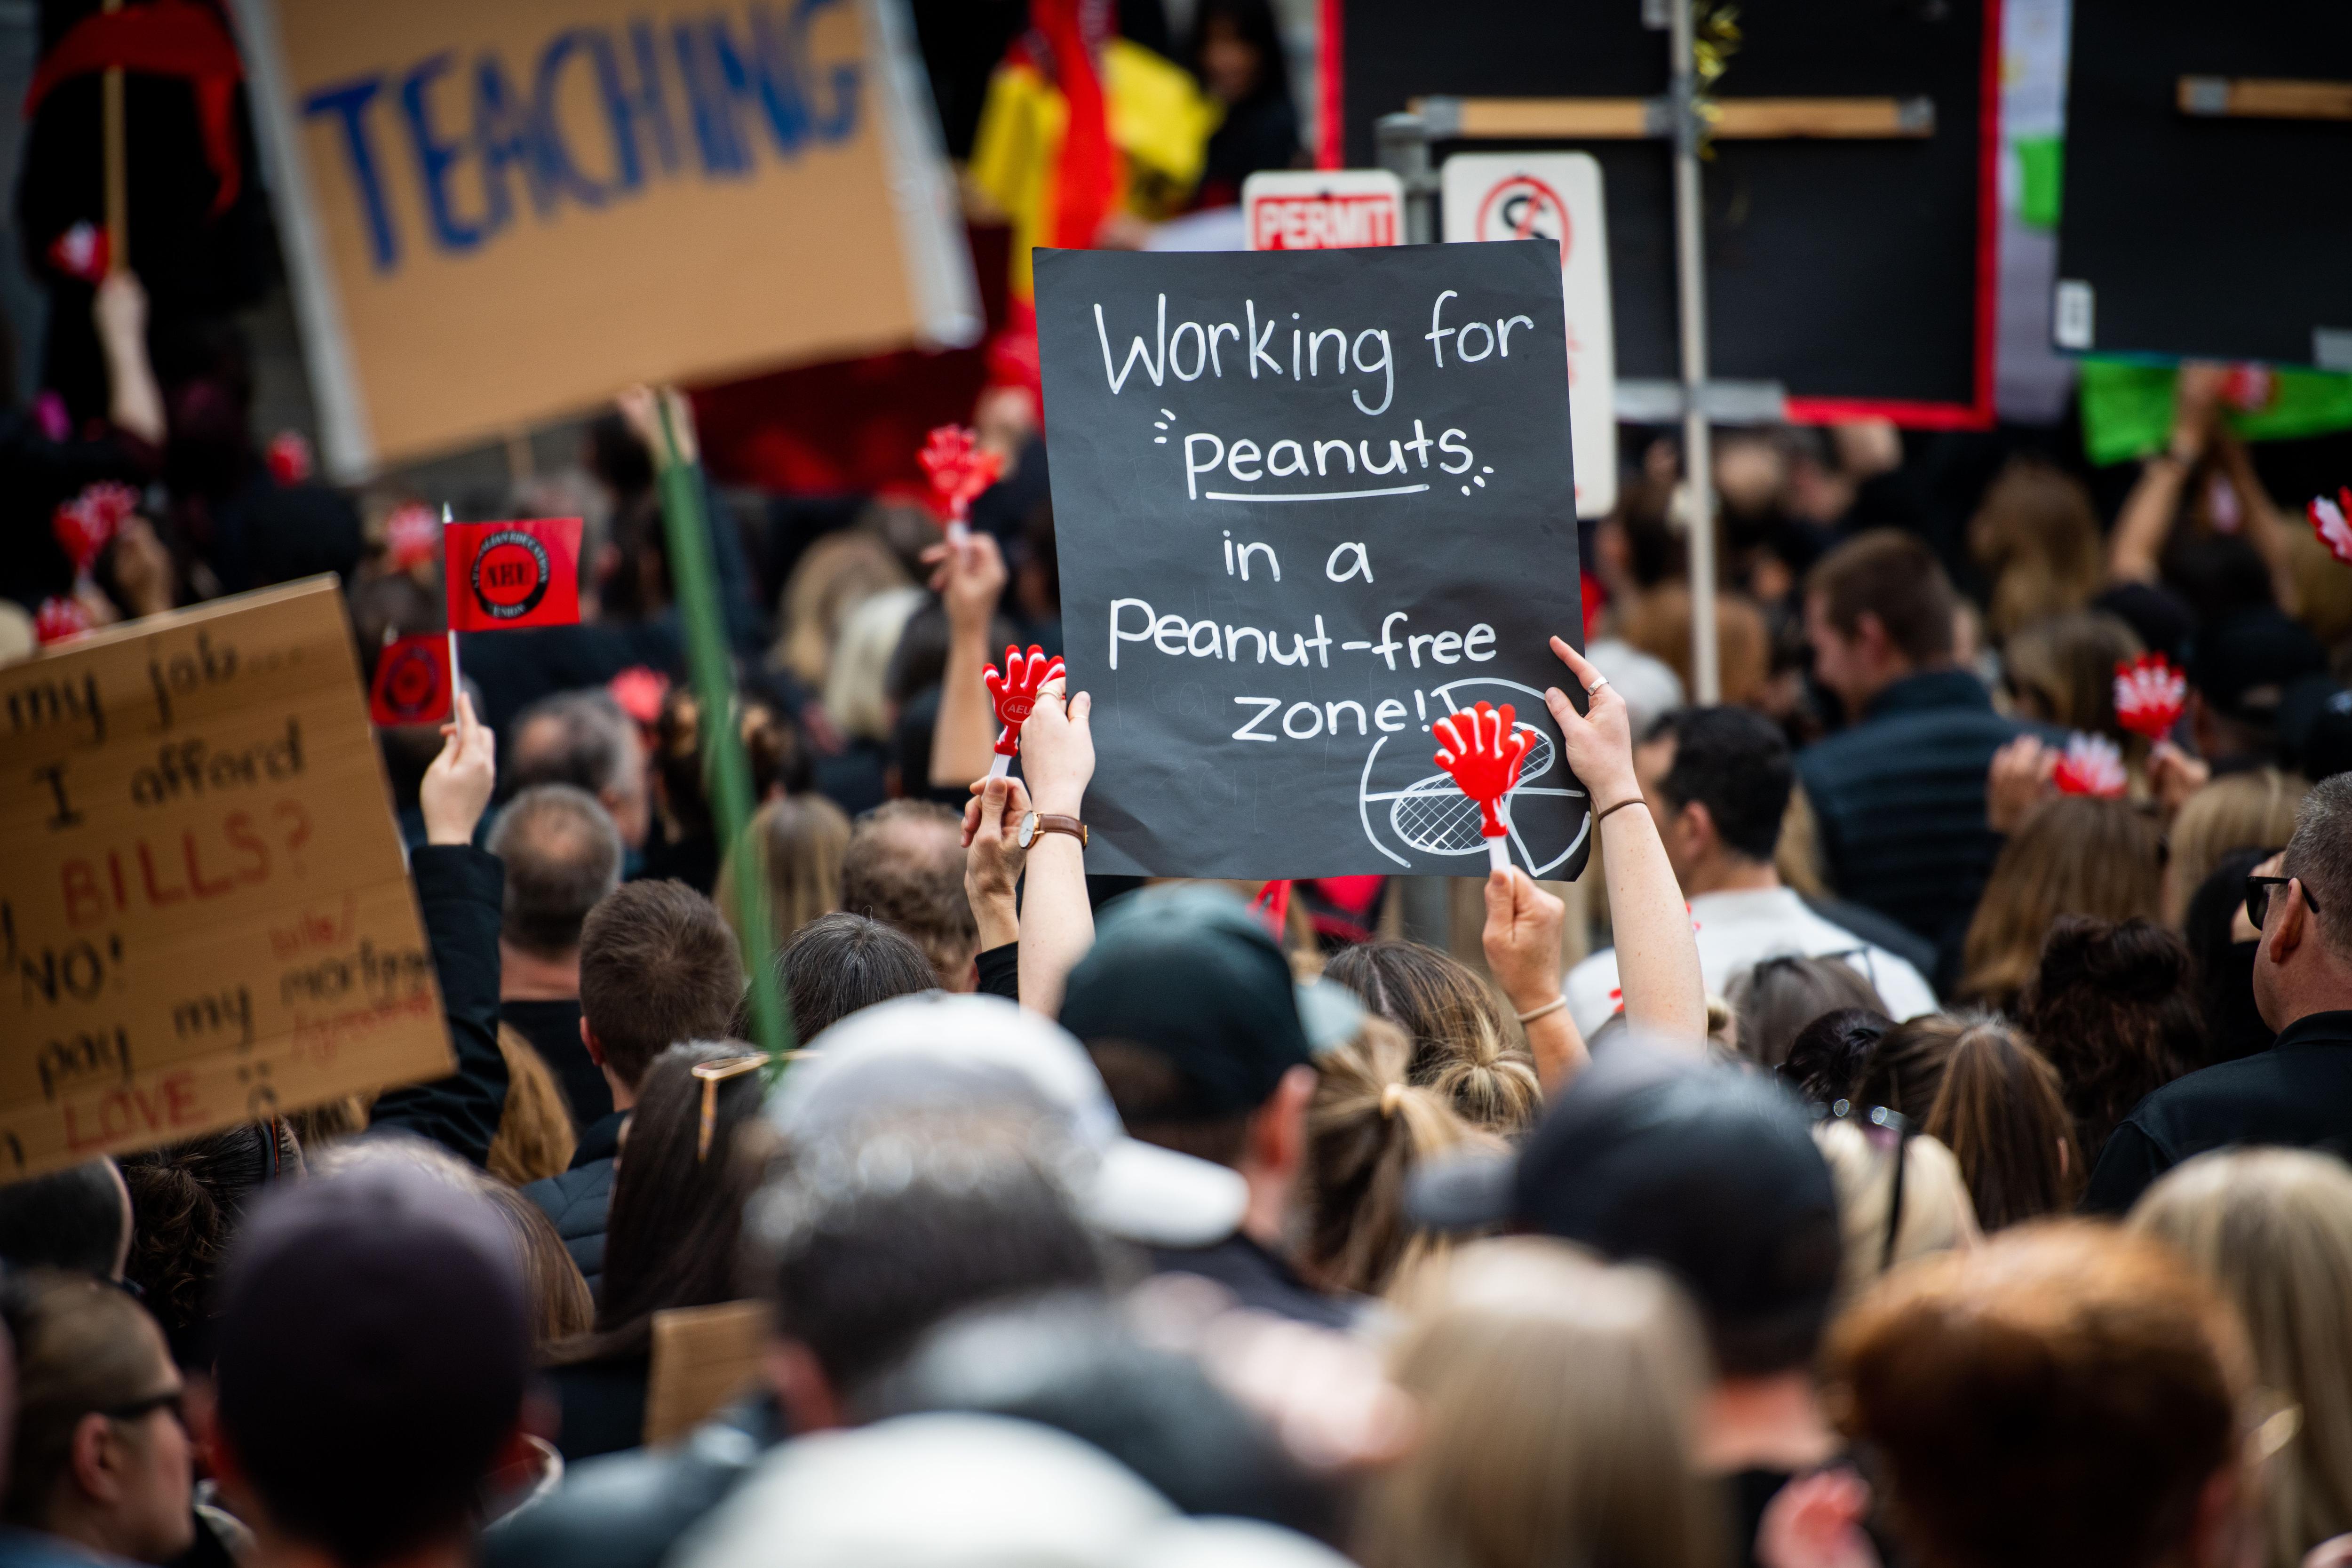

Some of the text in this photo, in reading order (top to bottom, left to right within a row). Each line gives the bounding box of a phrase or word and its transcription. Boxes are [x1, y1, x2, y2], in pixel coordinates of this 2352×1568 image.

[301, 0, 860, 277] TEACHING
[1259, 202, 1392, 248] PERMIT
[1093, 293, 1394, 416] Working
[1424, 289, 1534, 368] for
[1222, 529, 1374, 584] in a
[8, 668, 107, 748] my
[1007, 704, 1032, 715] AEU
[1231, 688, 1431, 743] zone!
[33, 713, 306, 830] I afford
[60, 797, 314, 931] BILLS?
[36, 1022, 135, 1102] pay
[172, 982, 254, 1053] my
[62, 1069, 211, 1158] LOVE
